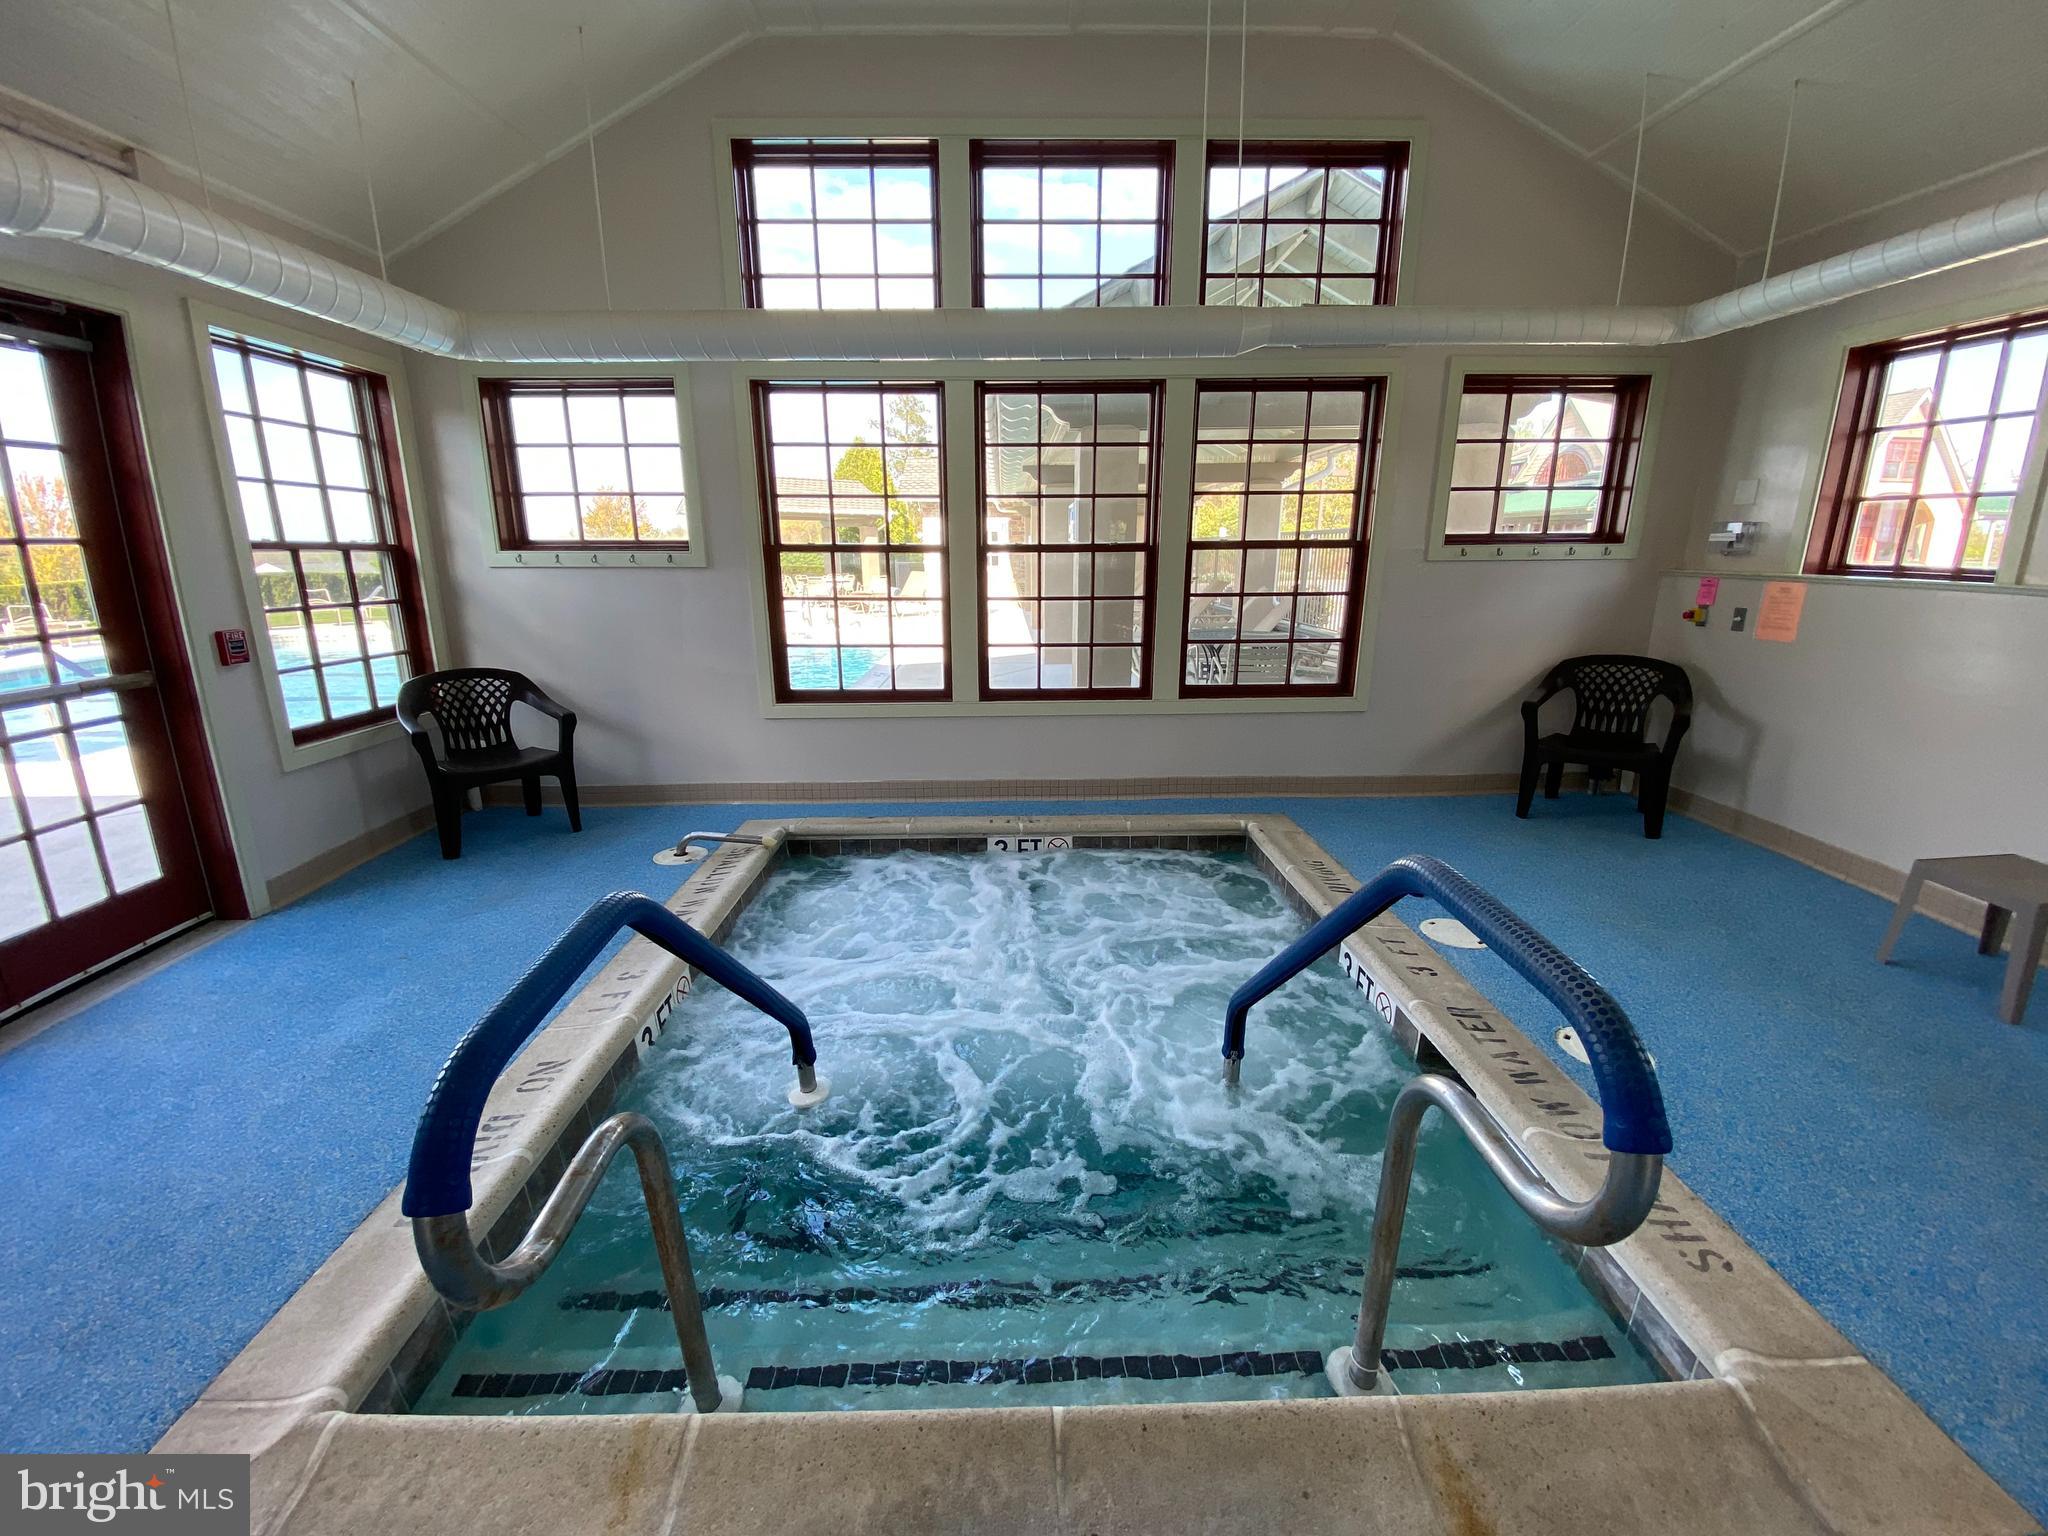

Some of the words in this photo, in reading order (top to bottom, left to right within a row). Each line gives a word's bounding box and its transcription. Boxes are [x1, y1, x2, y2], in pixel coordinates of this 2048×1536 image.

[226, 631, 244, 640] FIRE
[1018, 838, 1042, 853] FT
[1376, 936, 1419, 956] FT
[1356, 965, 1374, 1001] FT
[656, 993, 672, 1031] FT
[1446, 1006, 1547, 1085] WATER
[516, 1059, 571, 1093] NO
